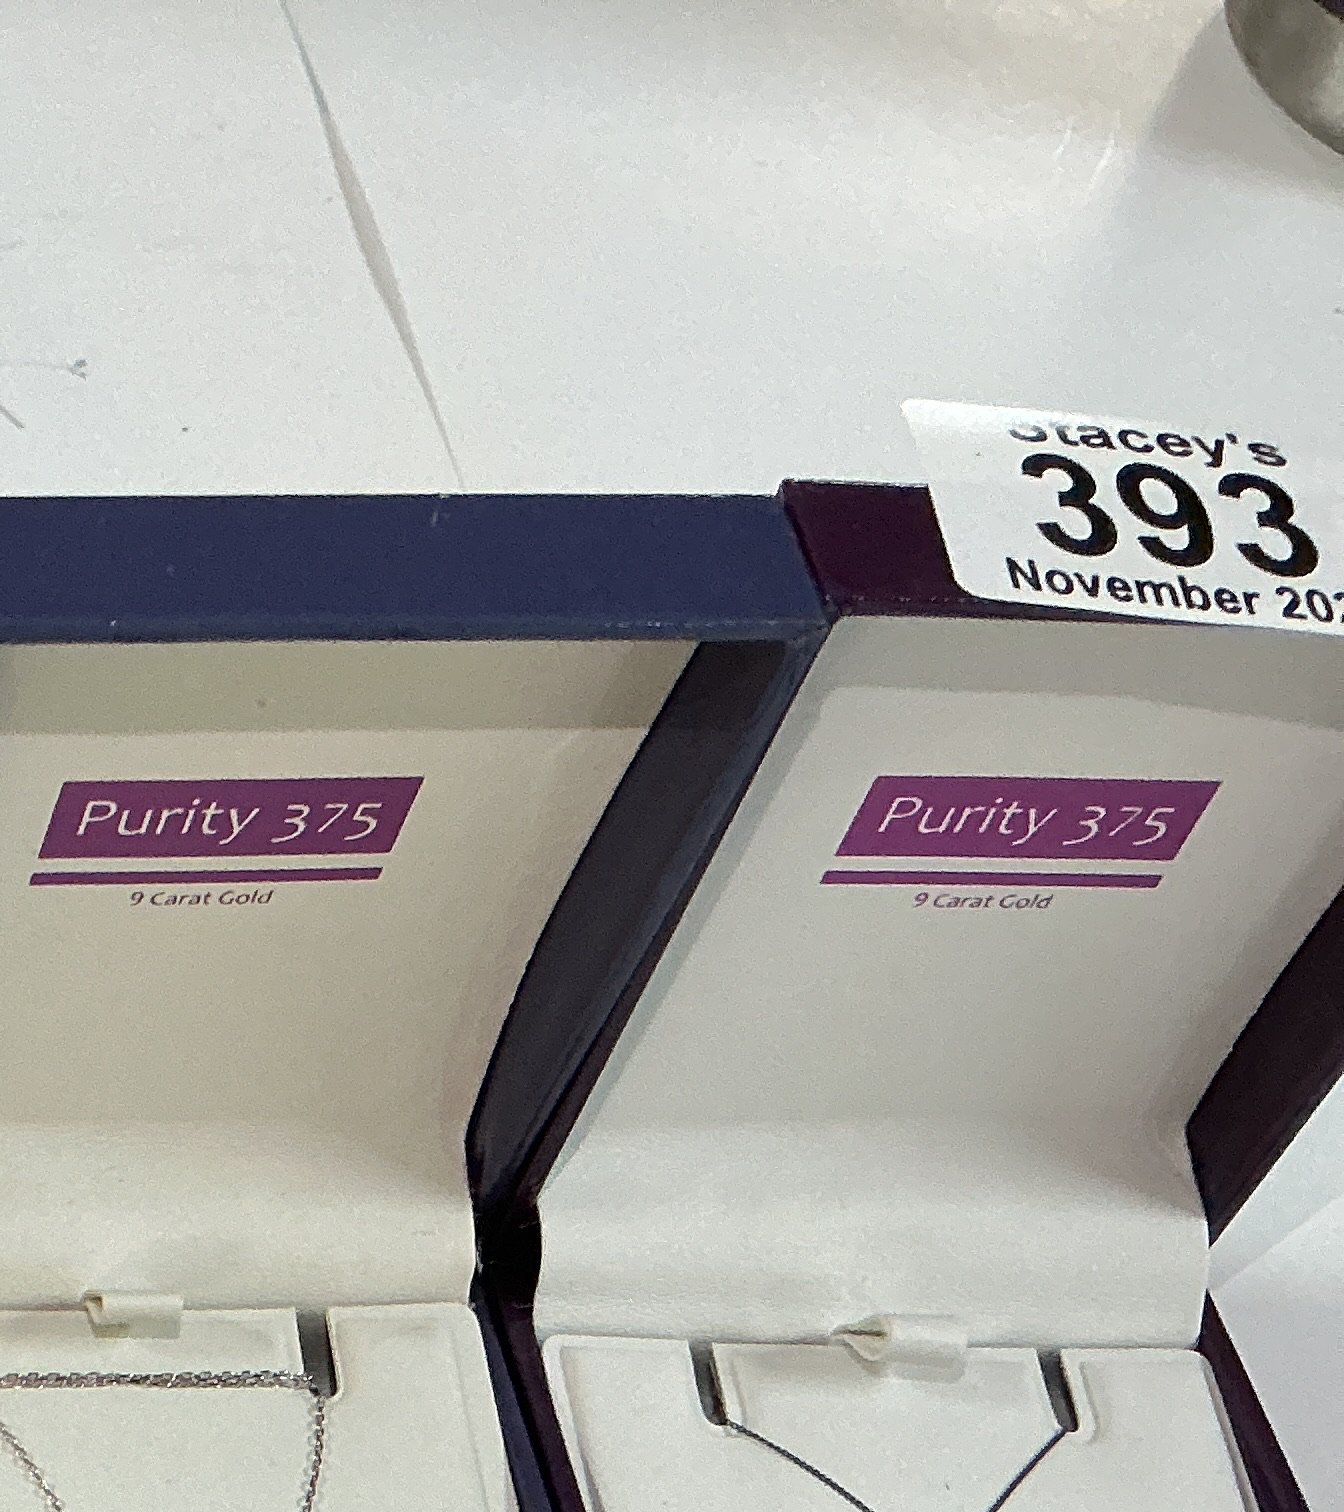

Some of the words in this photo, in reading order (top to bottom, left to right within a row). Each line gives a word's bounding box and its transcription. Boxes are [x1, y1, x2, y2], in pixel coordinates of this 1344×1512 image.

[1020, 452, 1320, 579] 393
[1005, 556, 1261, 616] November
[76, 798, 260, 845] Purity
[270, 802, 382, 843] 375
[877, 796, 1058, 846] Purity
[1062, 805, 1176, 846] 375
[130, 891, 145, 906] 9
[149, 891, 212, 906] Carat
[218, 889, 275, 905] Gold
[914, 891, 929, 908] 9
[933, 893, 995, 909] Carat
[998, 893, 1054, 909] Gold
